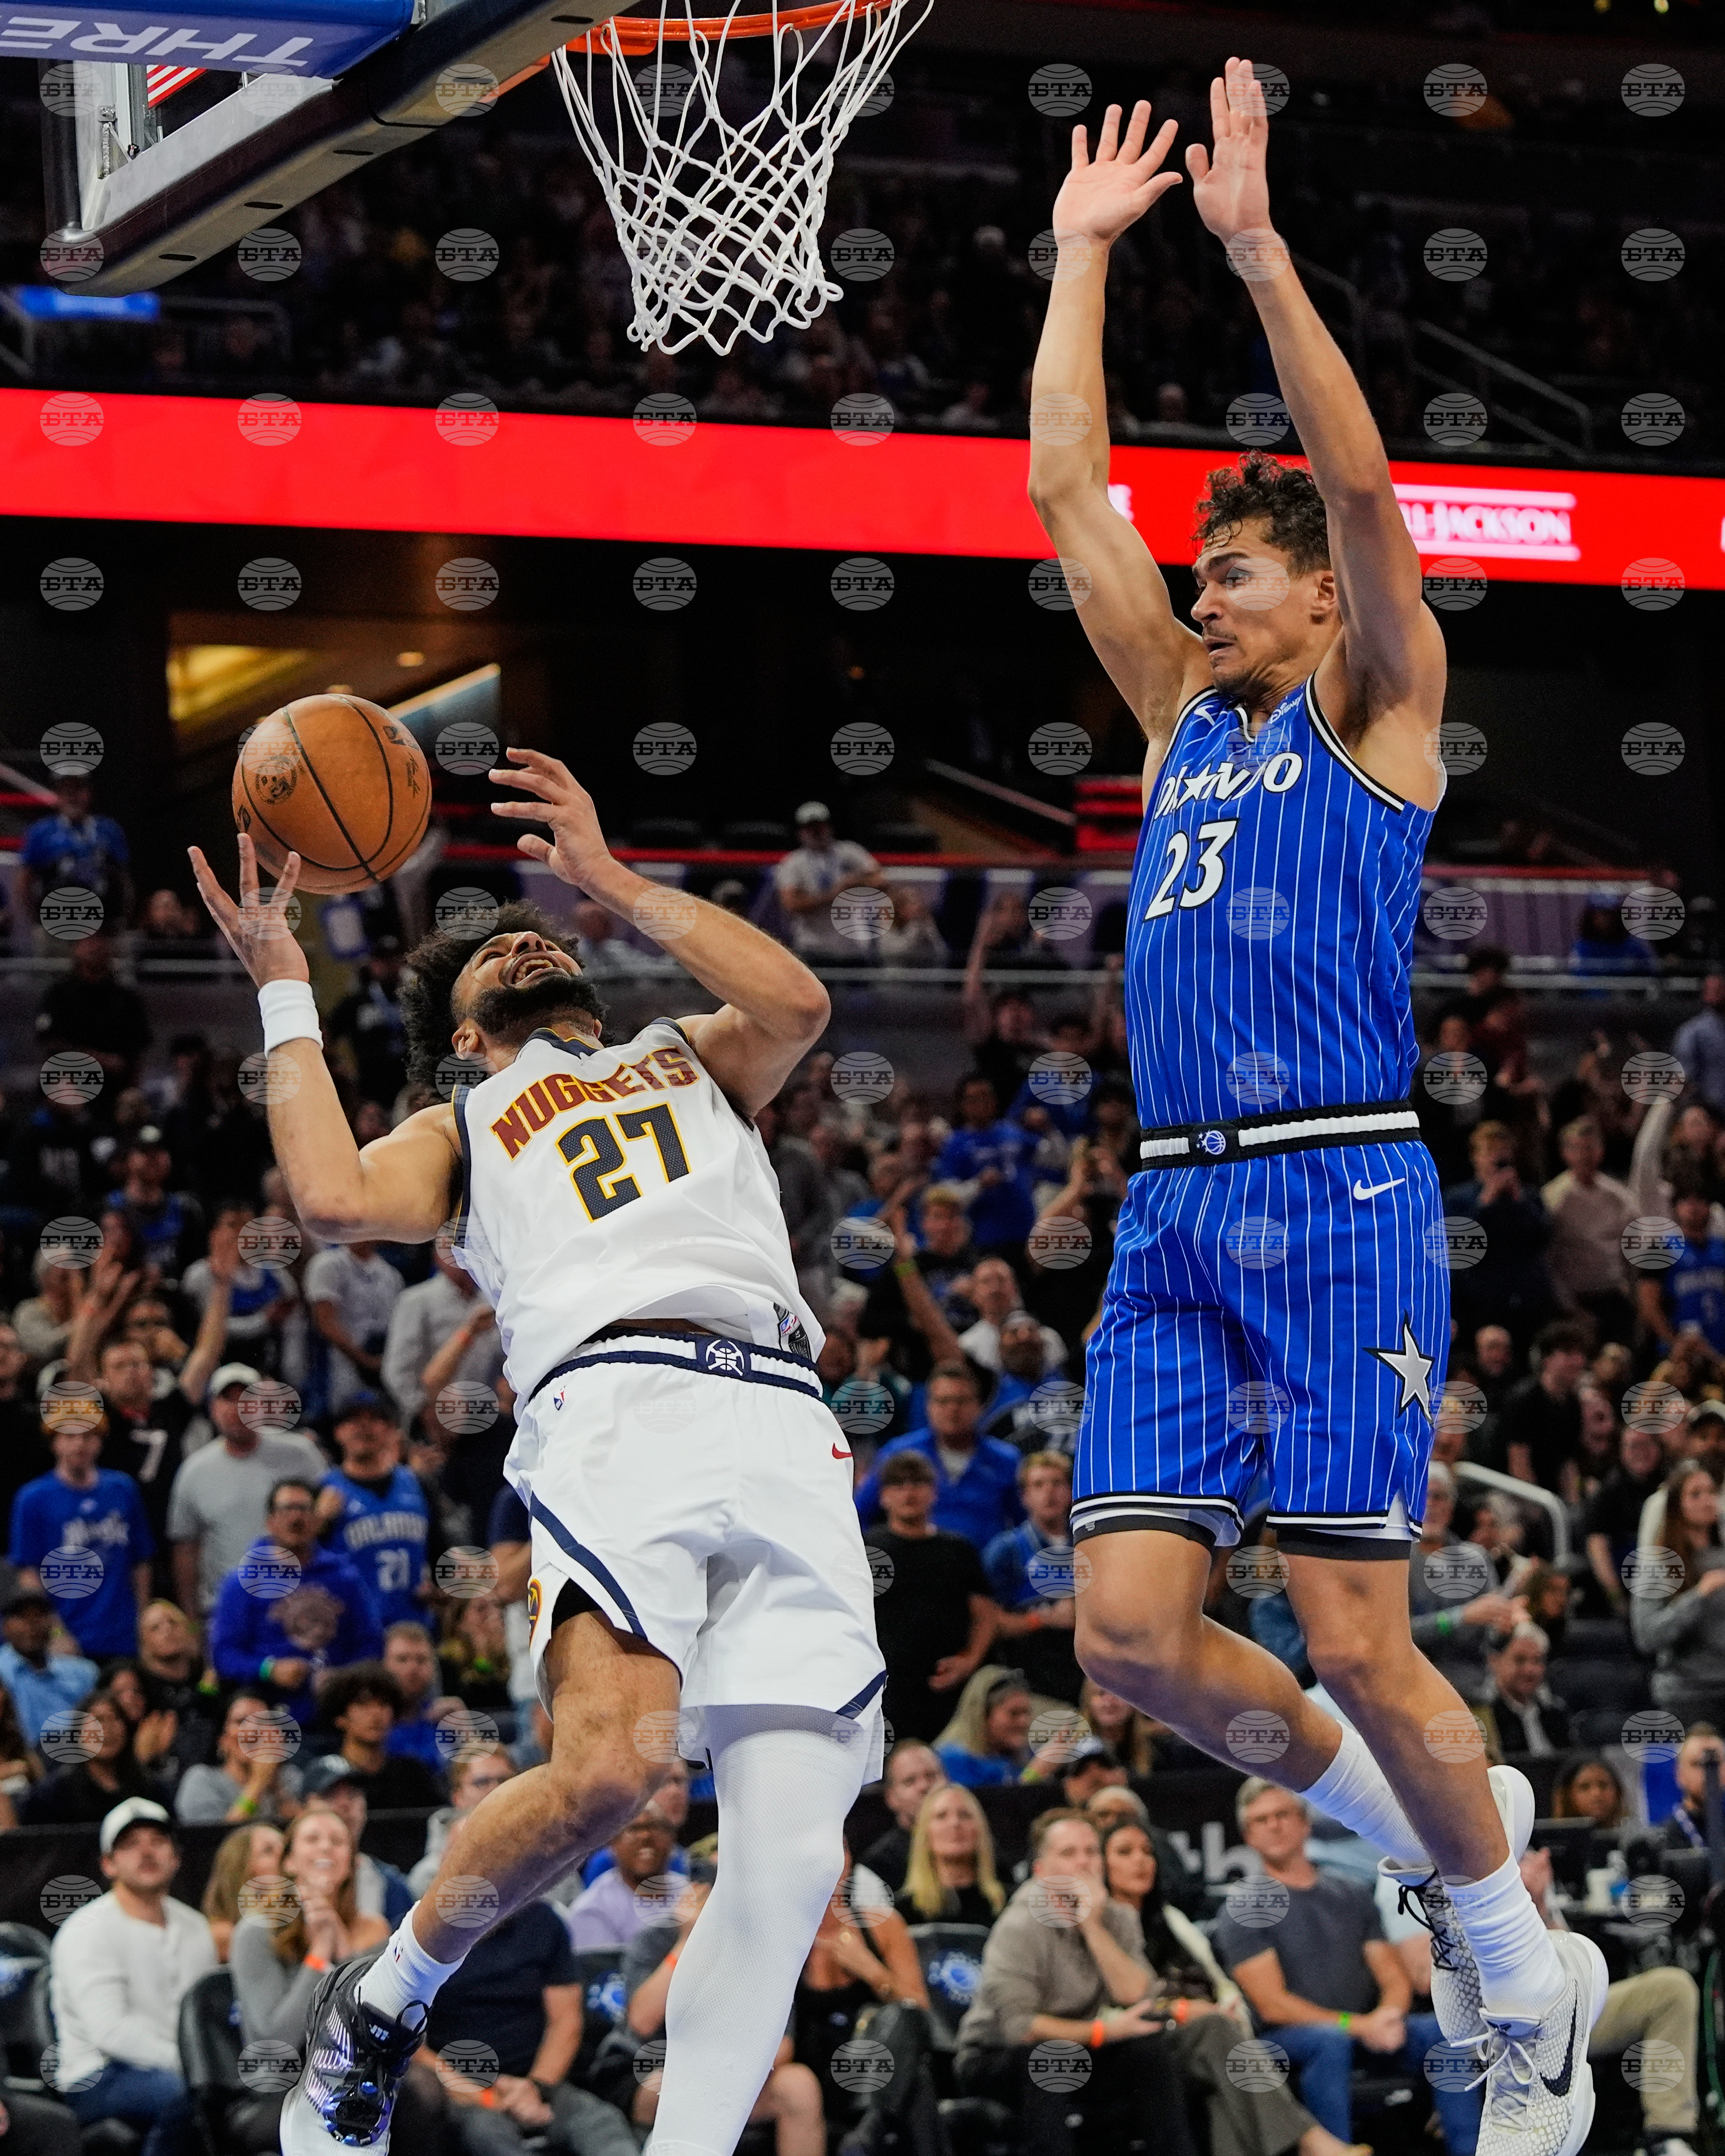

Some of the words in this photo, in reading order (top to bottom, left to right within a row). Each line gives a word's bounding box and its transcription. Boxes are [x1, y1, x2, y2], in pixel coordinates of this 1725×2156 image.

[0, 16, 313, 66] THRE
[1142, 818, 1239, 922] 23
[490, 1047, 700, 1161] NUGGETS
[555, 1101, 692, 1223] 27
[130, 1429, 168, 1483] 7
